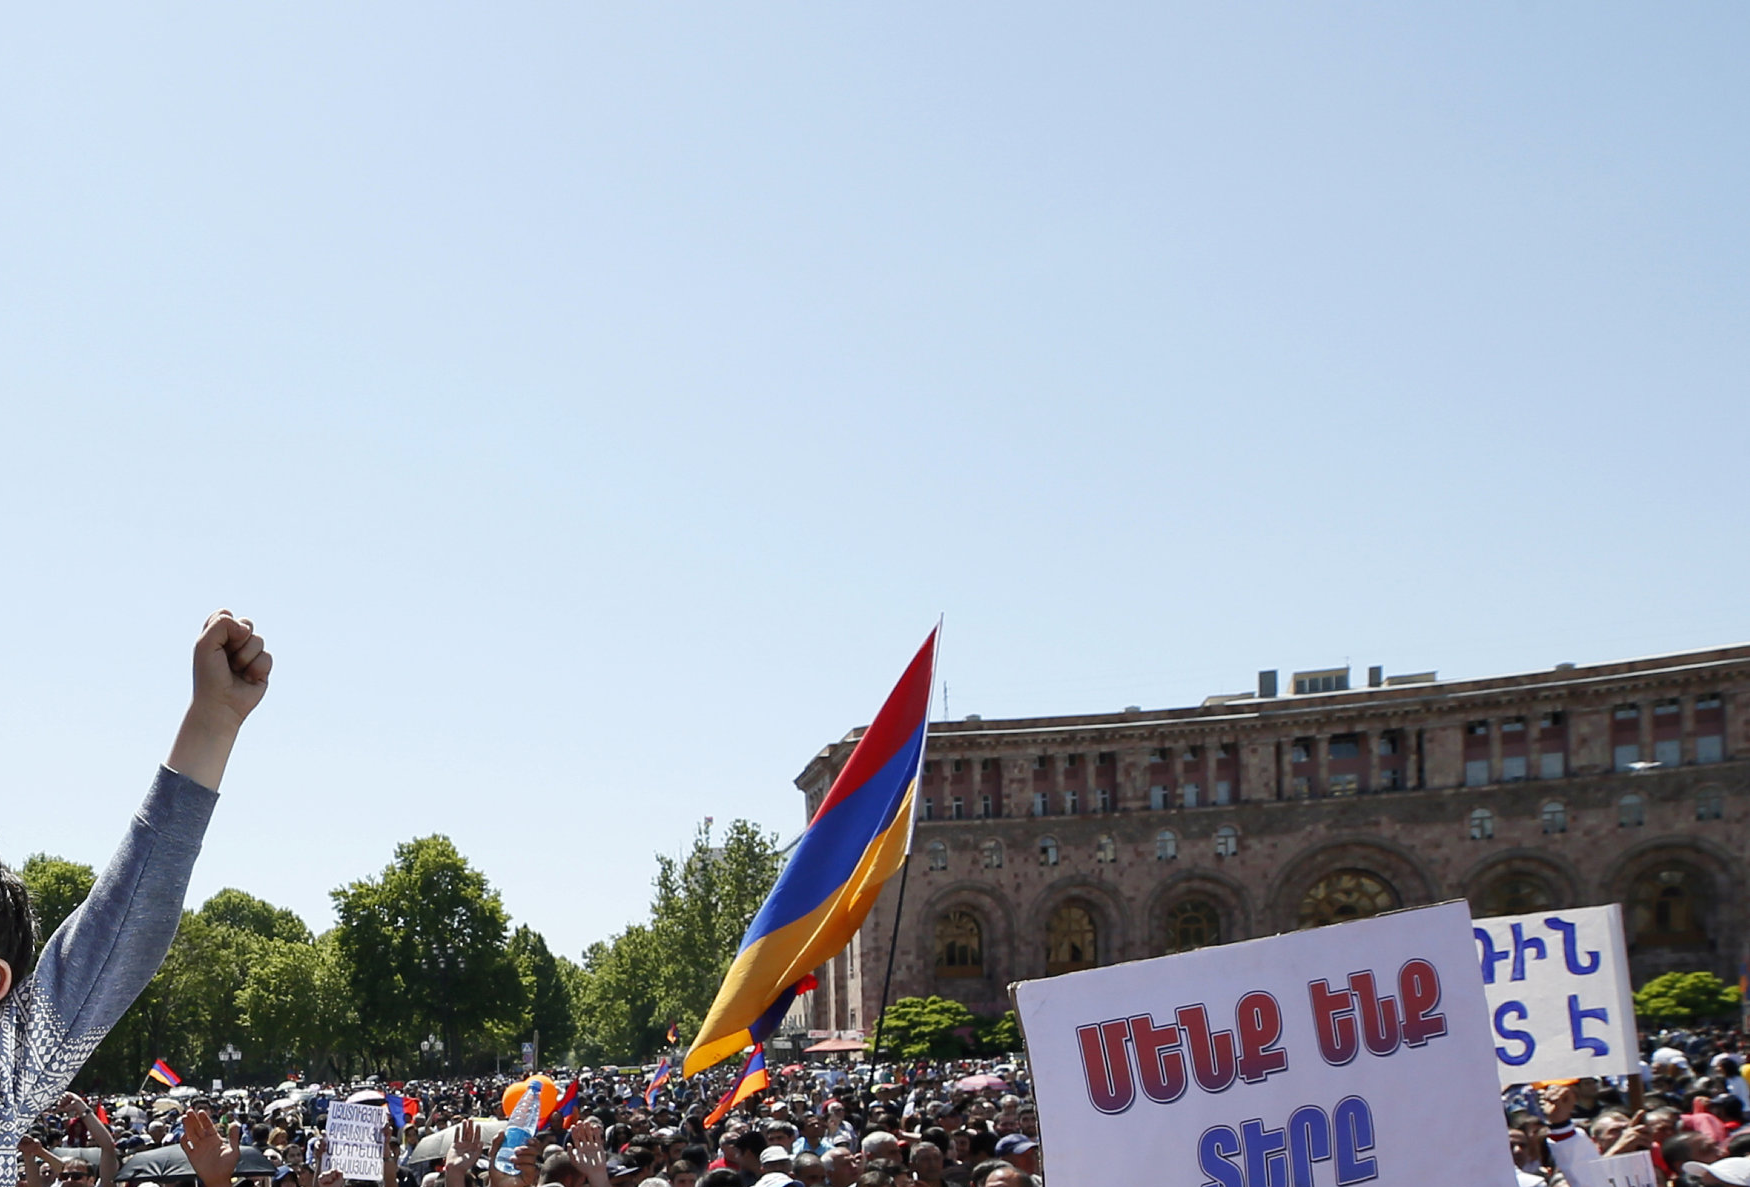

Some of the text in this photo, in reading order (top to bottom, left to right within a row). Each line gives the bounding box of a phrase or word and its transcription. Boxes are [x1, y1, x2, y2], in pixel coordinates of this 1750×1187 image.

[1077, 958, 1448, 1116] ՄԵՆՔ ԵՆՔ
[1568, 994, 1610, 1057] Է
